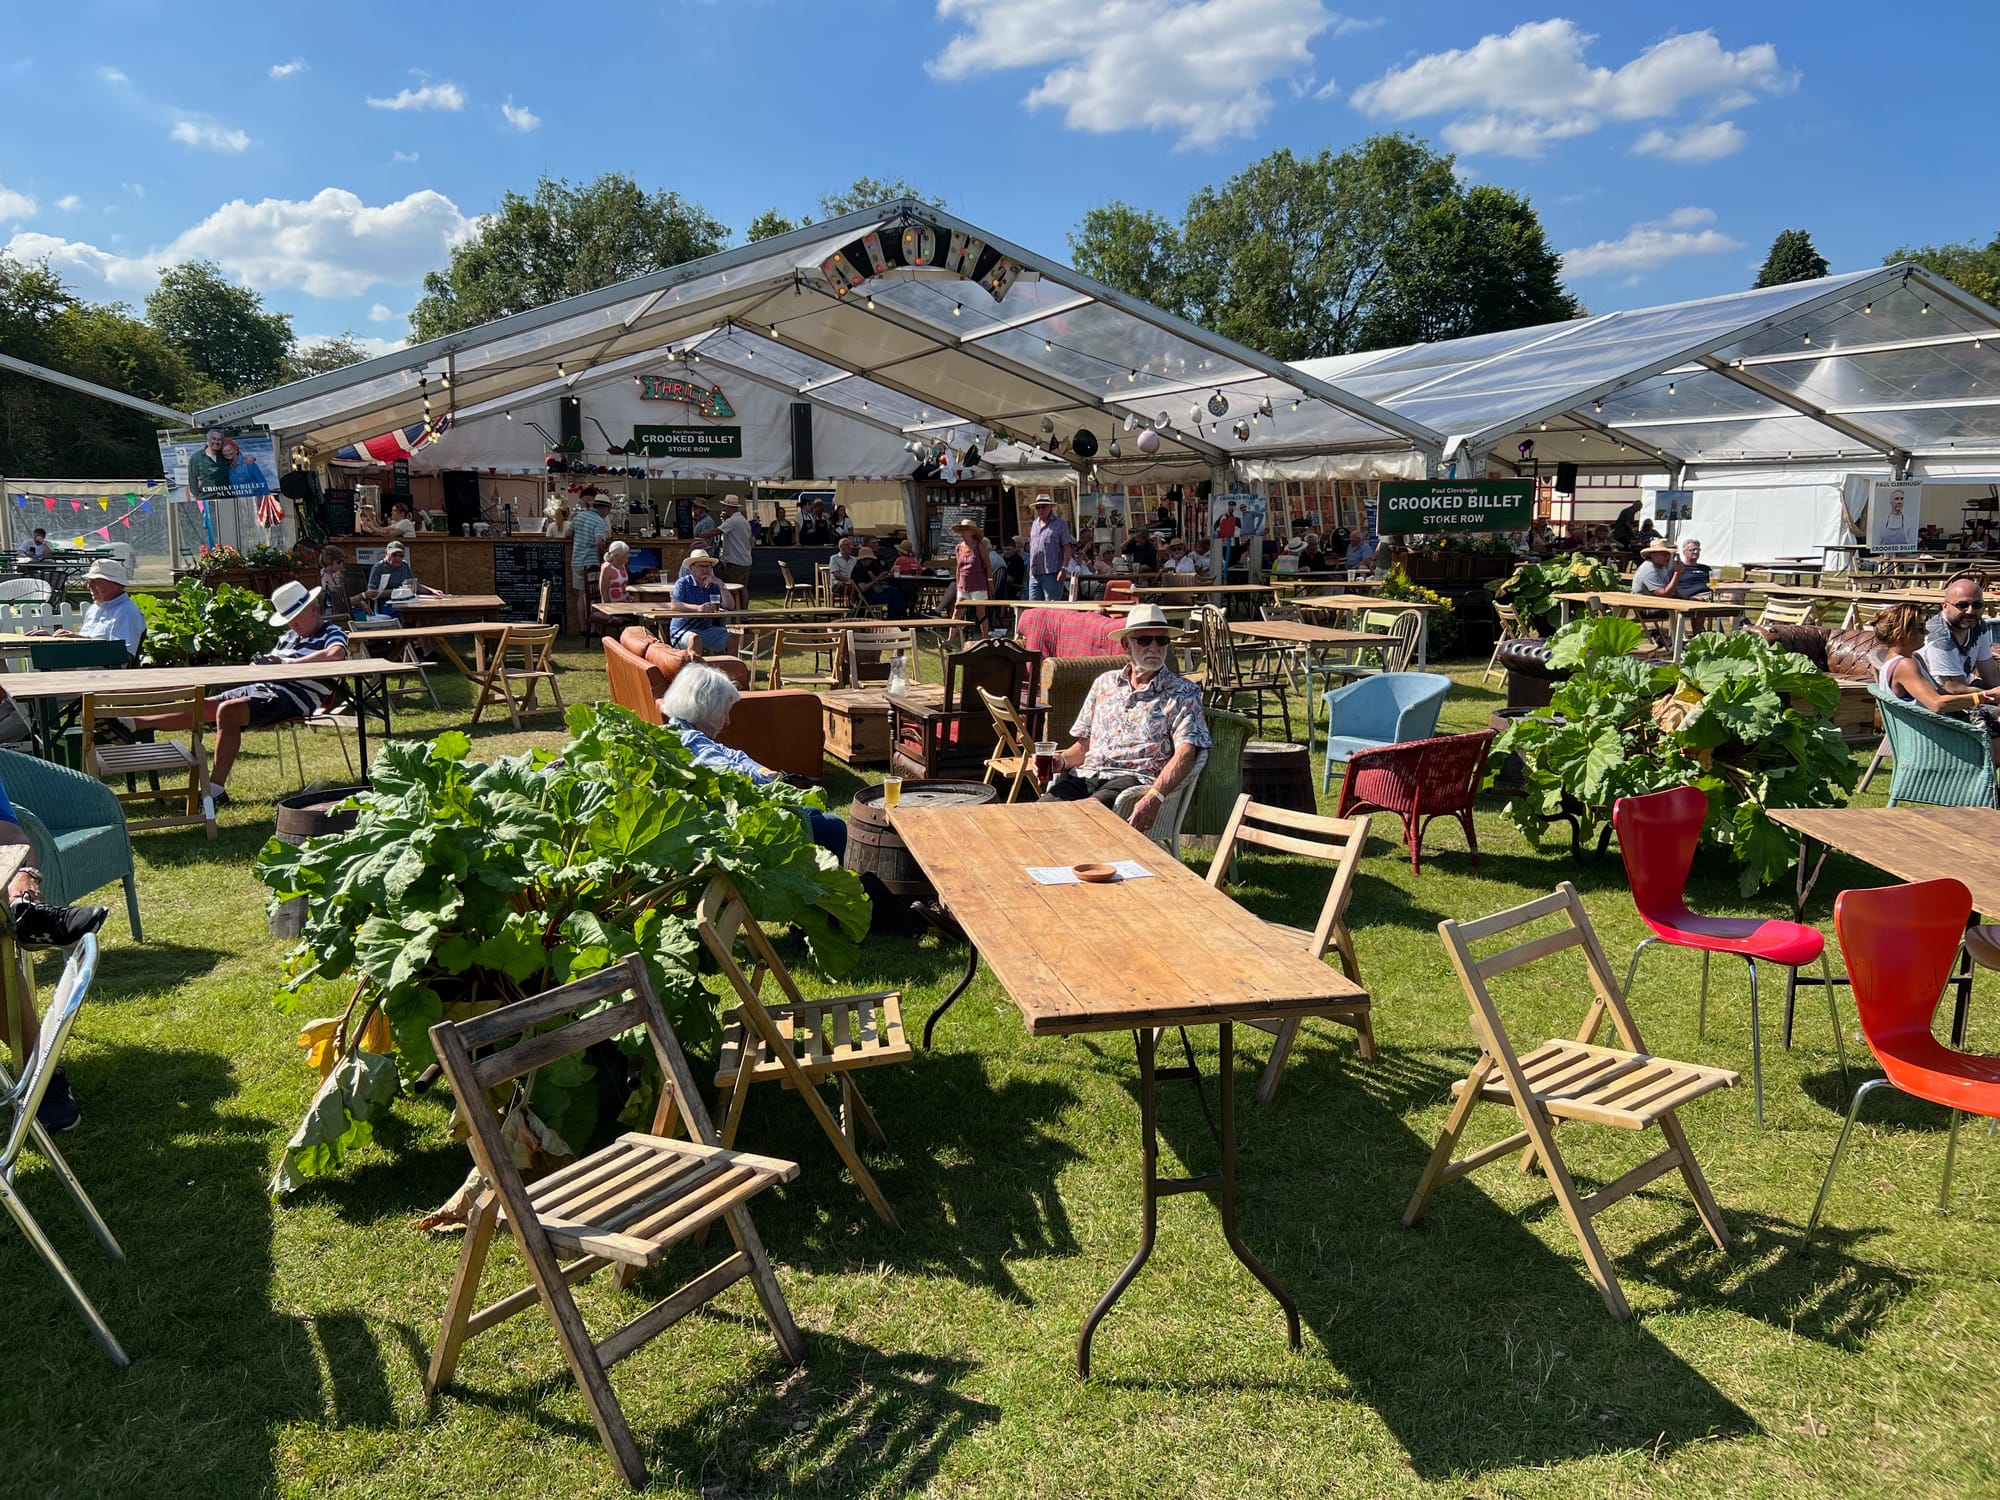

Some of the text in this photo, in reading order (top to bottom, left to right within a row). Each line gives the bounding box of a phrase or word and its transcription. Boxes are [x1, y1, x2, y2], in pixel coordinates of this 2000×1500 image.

[653, 381, 715, 408] THRILLS
[642, 435, 695, 443] CROOKED
[202, 482, 265, 493] CROOKED BILLET
[216, 489, 253, 497] SUNSHINE
[1388, 495, 1522, 510] CROOKED BILLET
[1422, 514, 1485, 525] STOKE ROW
